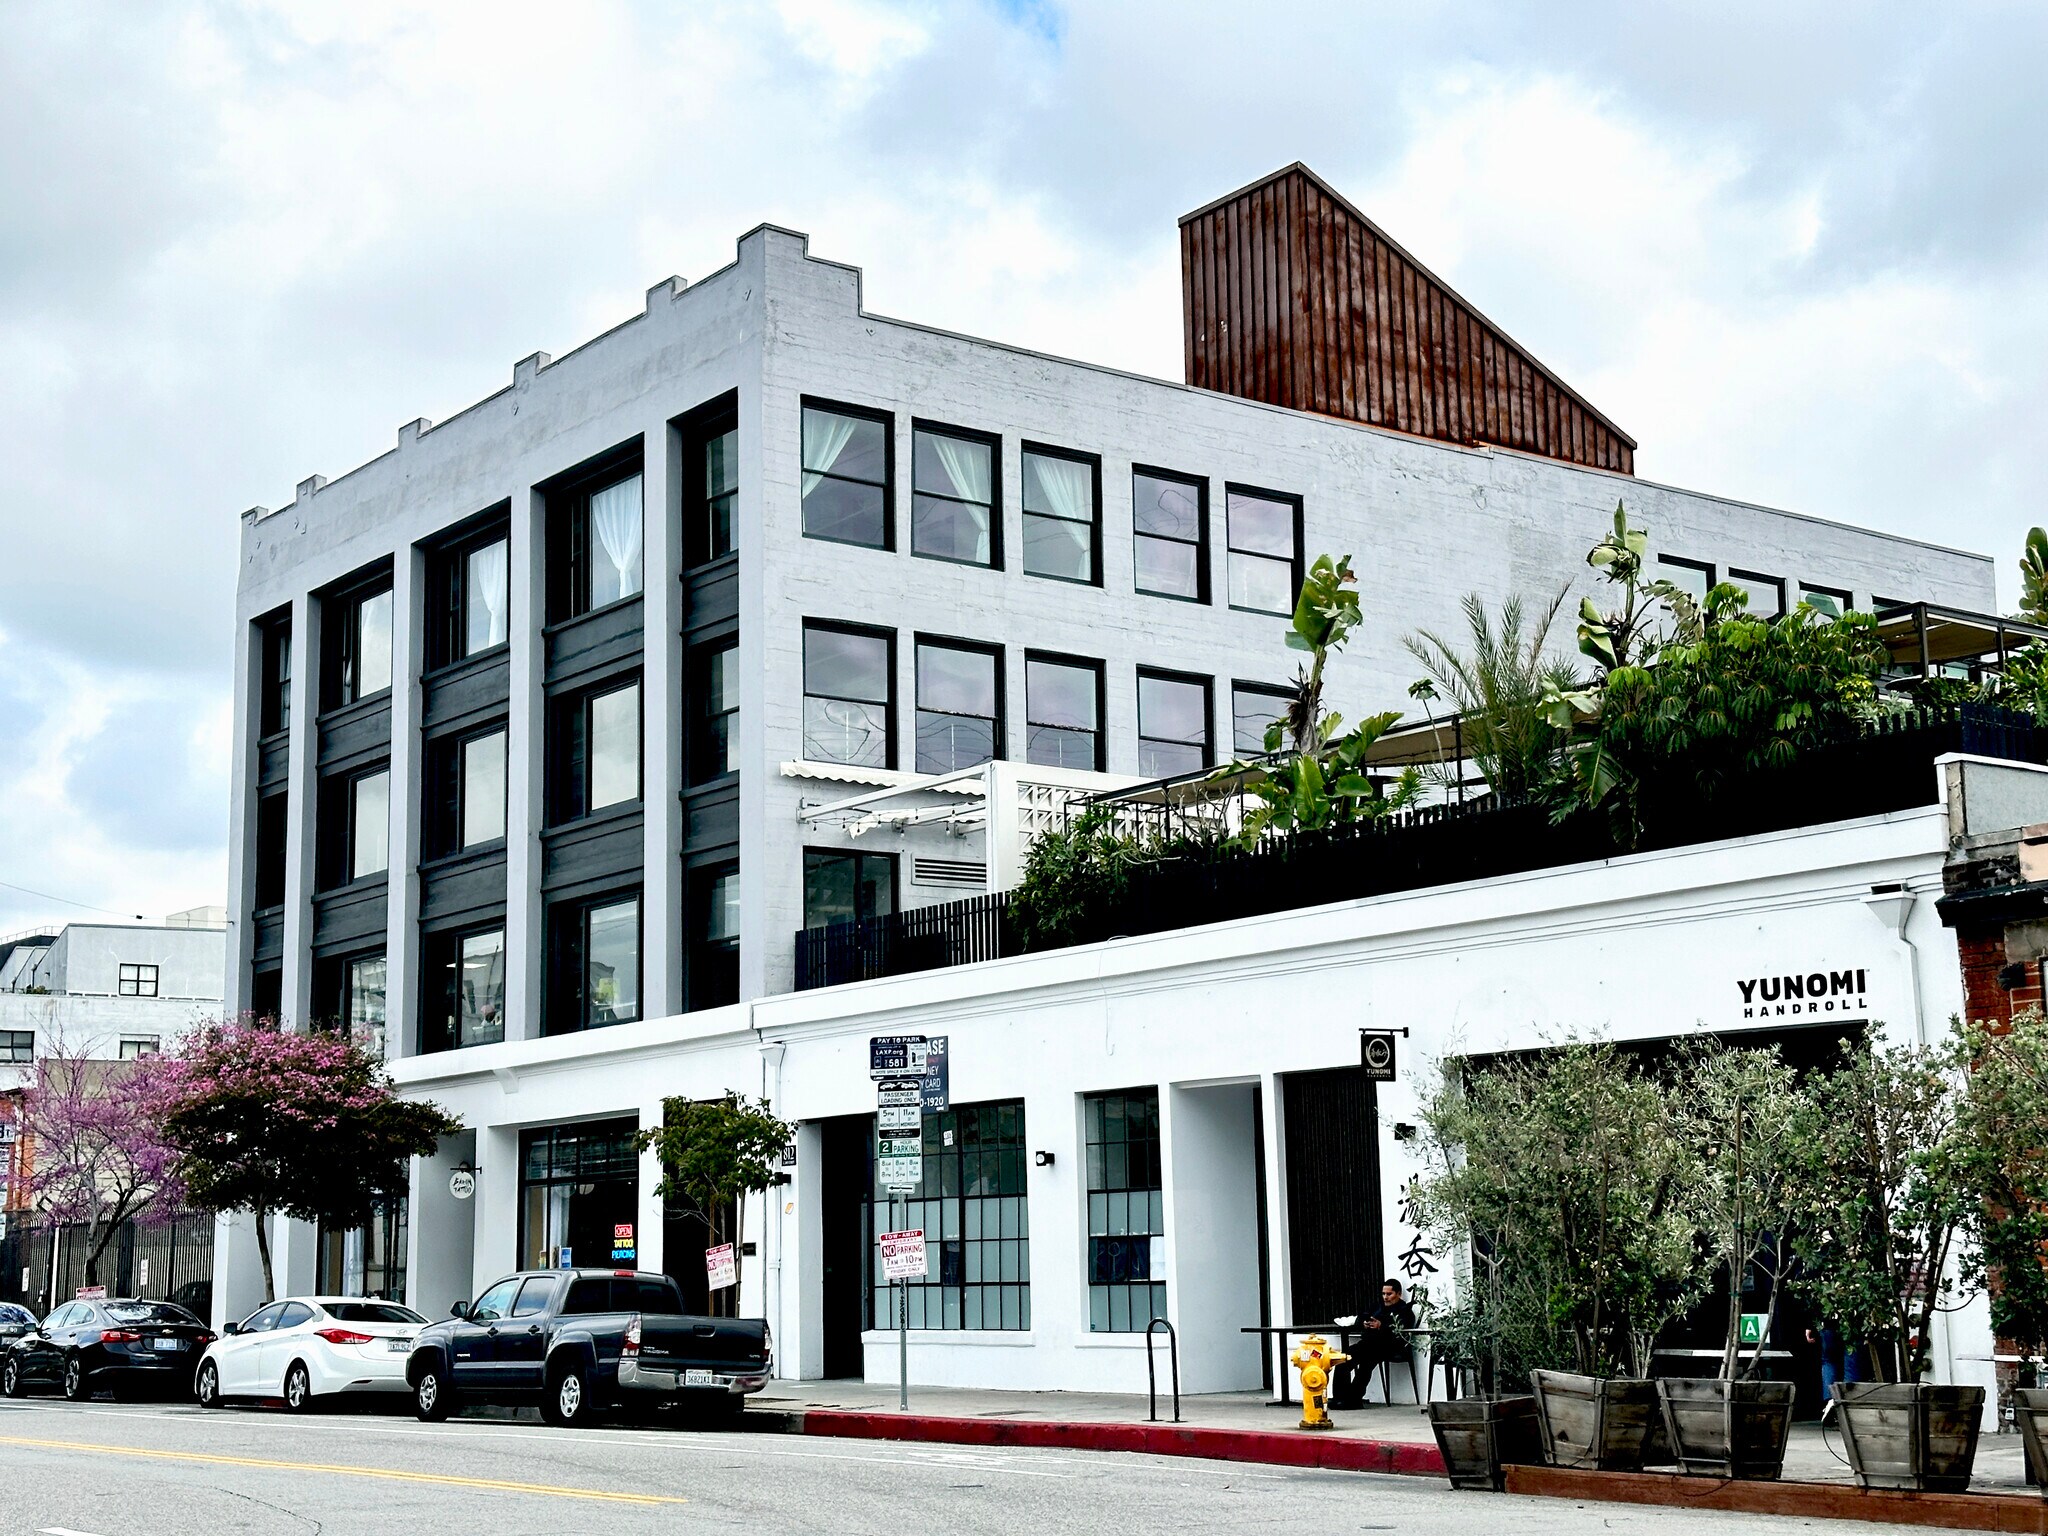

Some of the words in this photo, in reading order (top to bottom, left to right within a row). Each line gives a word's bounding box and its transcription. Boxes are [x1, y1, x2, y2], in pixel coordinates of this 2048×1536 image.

[1736, 968, 1866, 1004] YUNOMI
[1744, 998, 1867, 1018] HANDROLL
[926, 1039, 944, 1055] ASE
[888, 1058, 903, 1067] 581
[920, 1096, 944, 1108] 0-1920
[882, 1142, 889, 1152] 2
[893, 1145, 920, 1154] PARKING
[616, 1226, 632, 1236] OPEN
[885, 1231, 918, 1240] TOW-AWAY
[613, 1239, 634, 1248] TATTOO
[882, 1245, 896, 1257] NO
[897, 1243, 923, 1254] PARKING
[905, 1255, 923, 1264] 10PM
[1745, 1320, 1757, 1336] A
